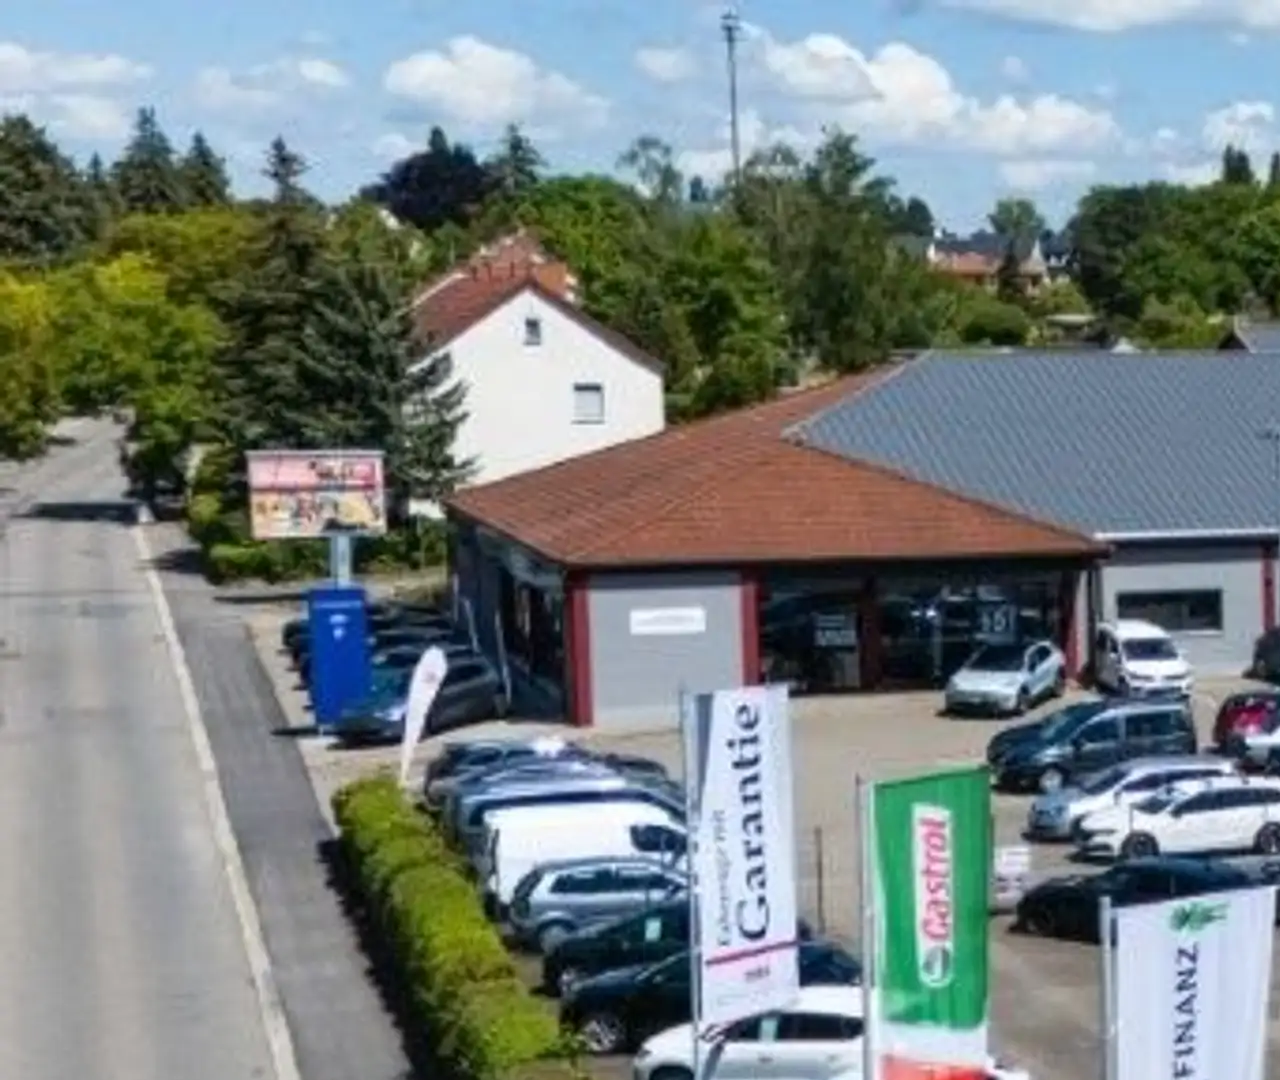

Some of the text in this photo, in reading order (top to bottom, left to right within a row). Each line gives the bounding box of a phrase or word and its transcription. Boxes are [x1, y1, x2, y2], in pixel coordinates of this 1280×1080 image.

[727, 703, 770, 939] Garantie
[919, 817, 949, 942] Castrol
[1172, 941, 1199, 1079] FINANZ
